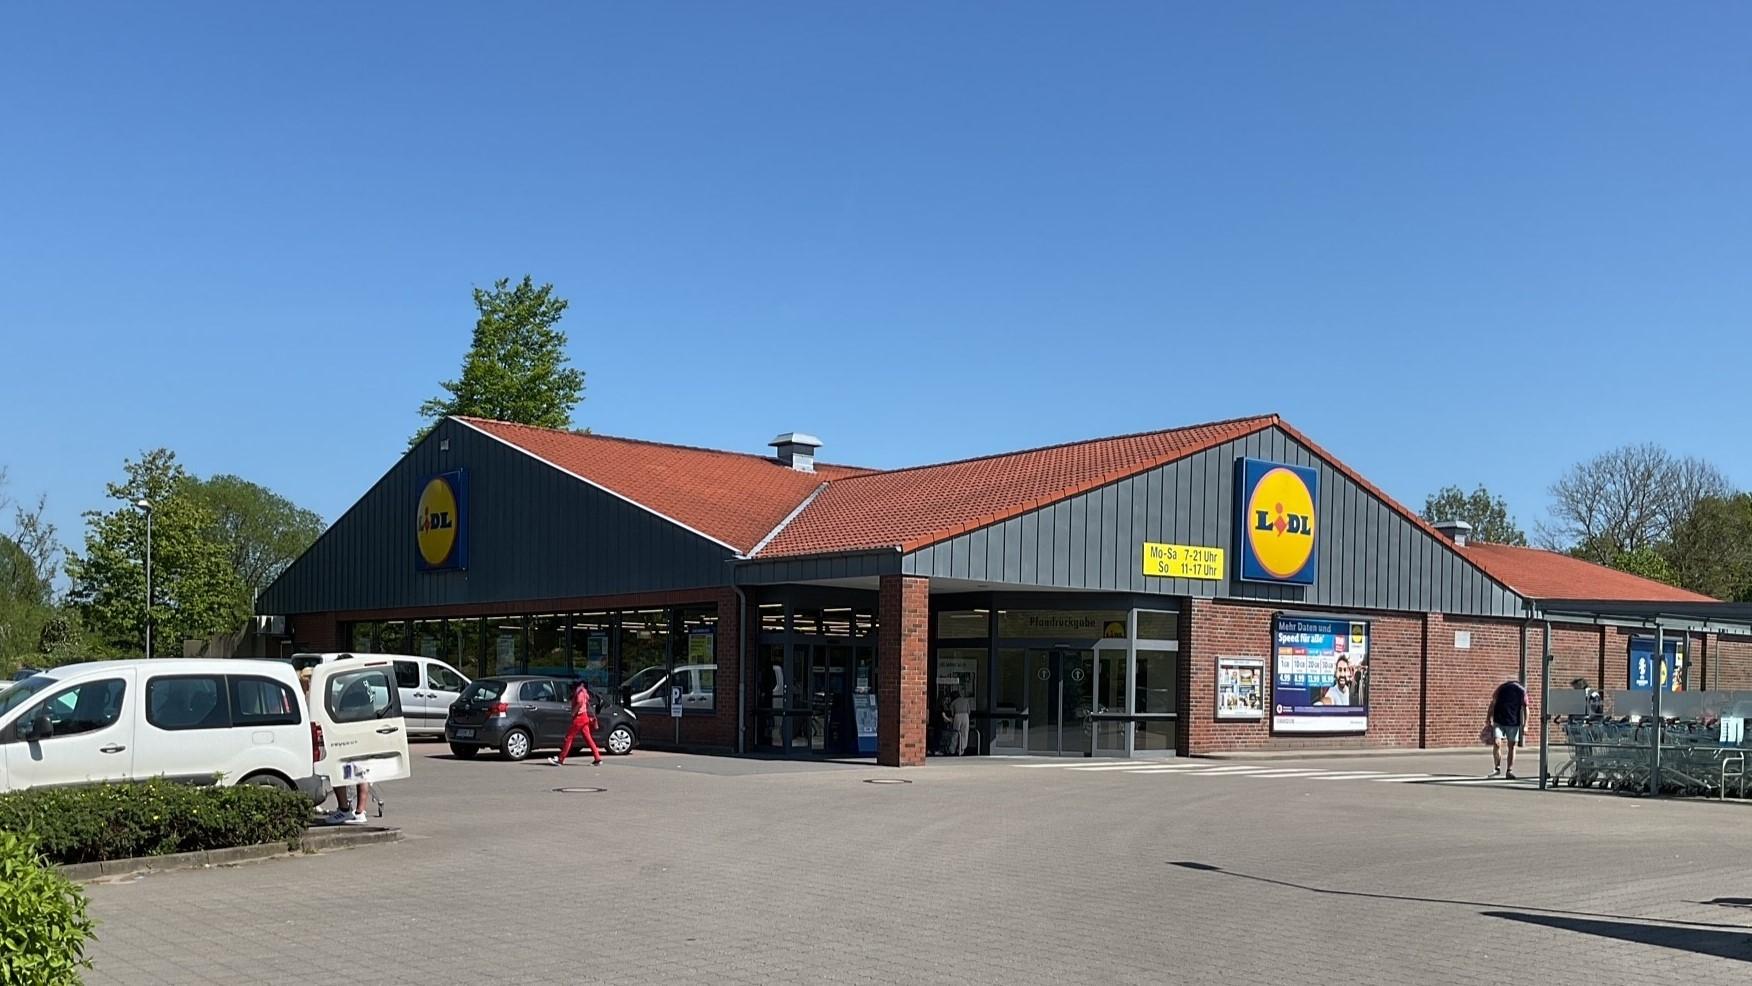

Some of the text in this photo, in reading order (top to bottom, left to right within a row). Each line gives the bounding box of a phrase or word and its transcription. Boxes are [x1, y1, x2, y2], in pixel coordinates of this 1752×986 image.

[1150, 546, 1218, 563] Mo-Sa 7-21 Uhr
[1158, 561, 1217, 576] So 11-17 Uhr
[1278, 621, 1332, 633] Mehr Daten und
[1278, 633, 1299, 645] Speed
[1300, 634, 1310, 643] für
[672, 687, 680, 704] P
